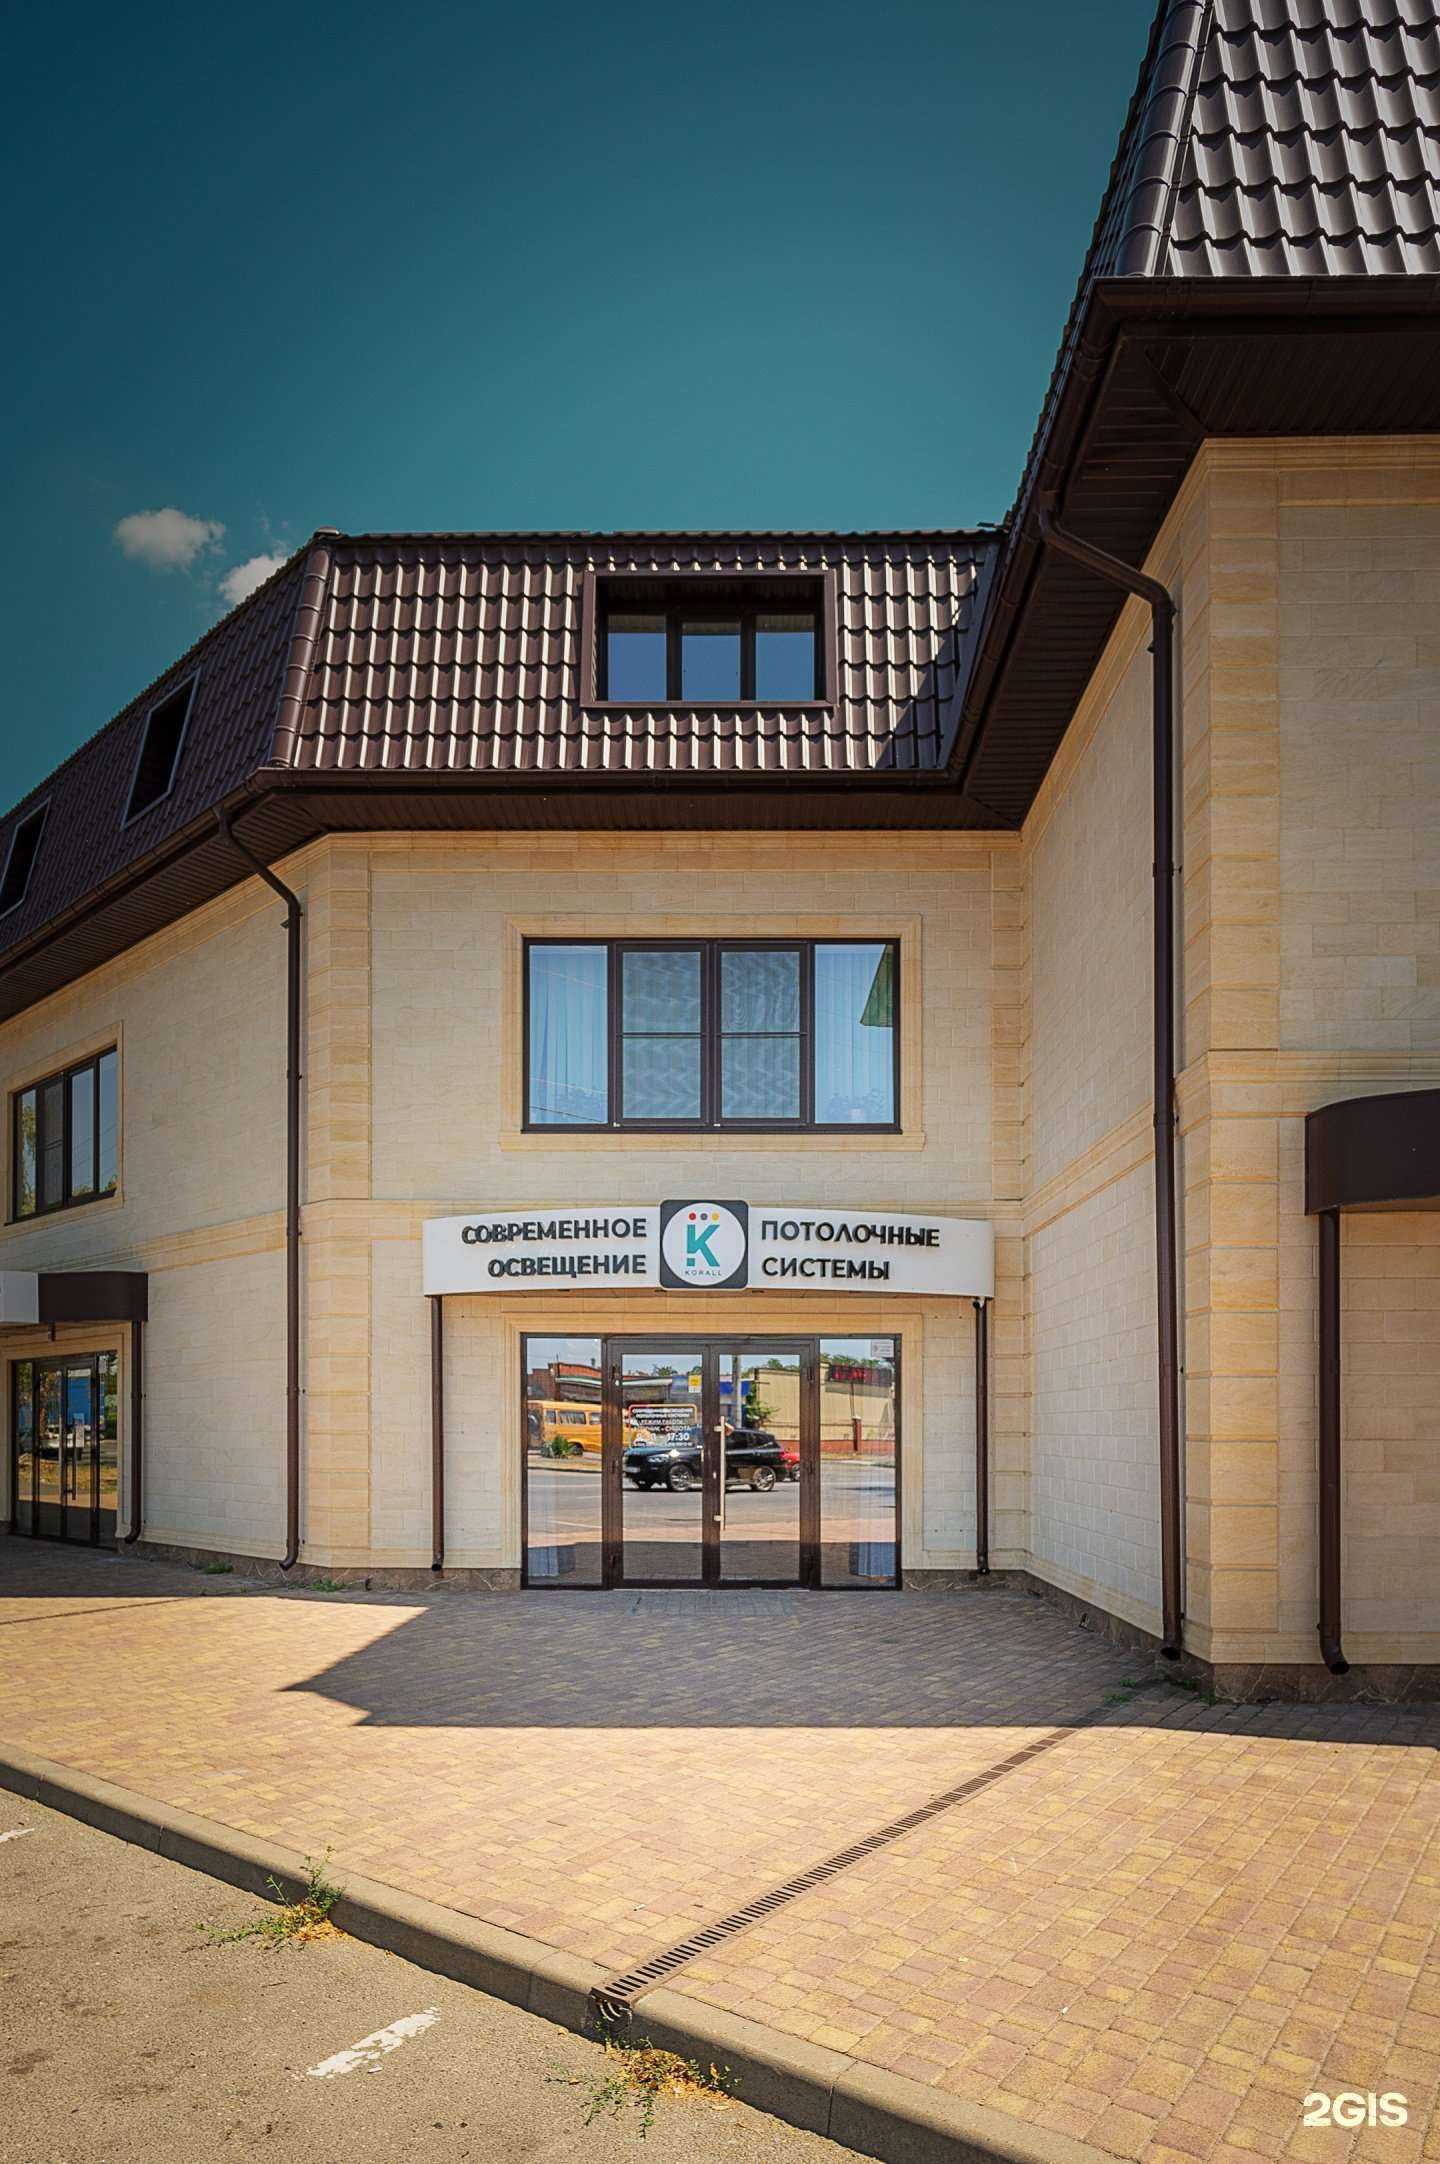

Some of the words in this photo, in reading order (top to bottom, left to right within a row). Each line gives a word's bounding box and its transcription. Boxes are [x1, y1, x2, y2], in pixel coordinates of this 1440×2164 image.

[461, 1218, 647, 1244] СОВРЕМЕННОЕ
[761, 1220, 940, 1247] ПОТОЛОЧНЫЕ
[487, 1254, 647, 1278] ОСВЕЩЕНИЕ
[761, 1257, 890, 1280] СИСТЕМЫ
[667, 1432, 690, 1441] 17:30
